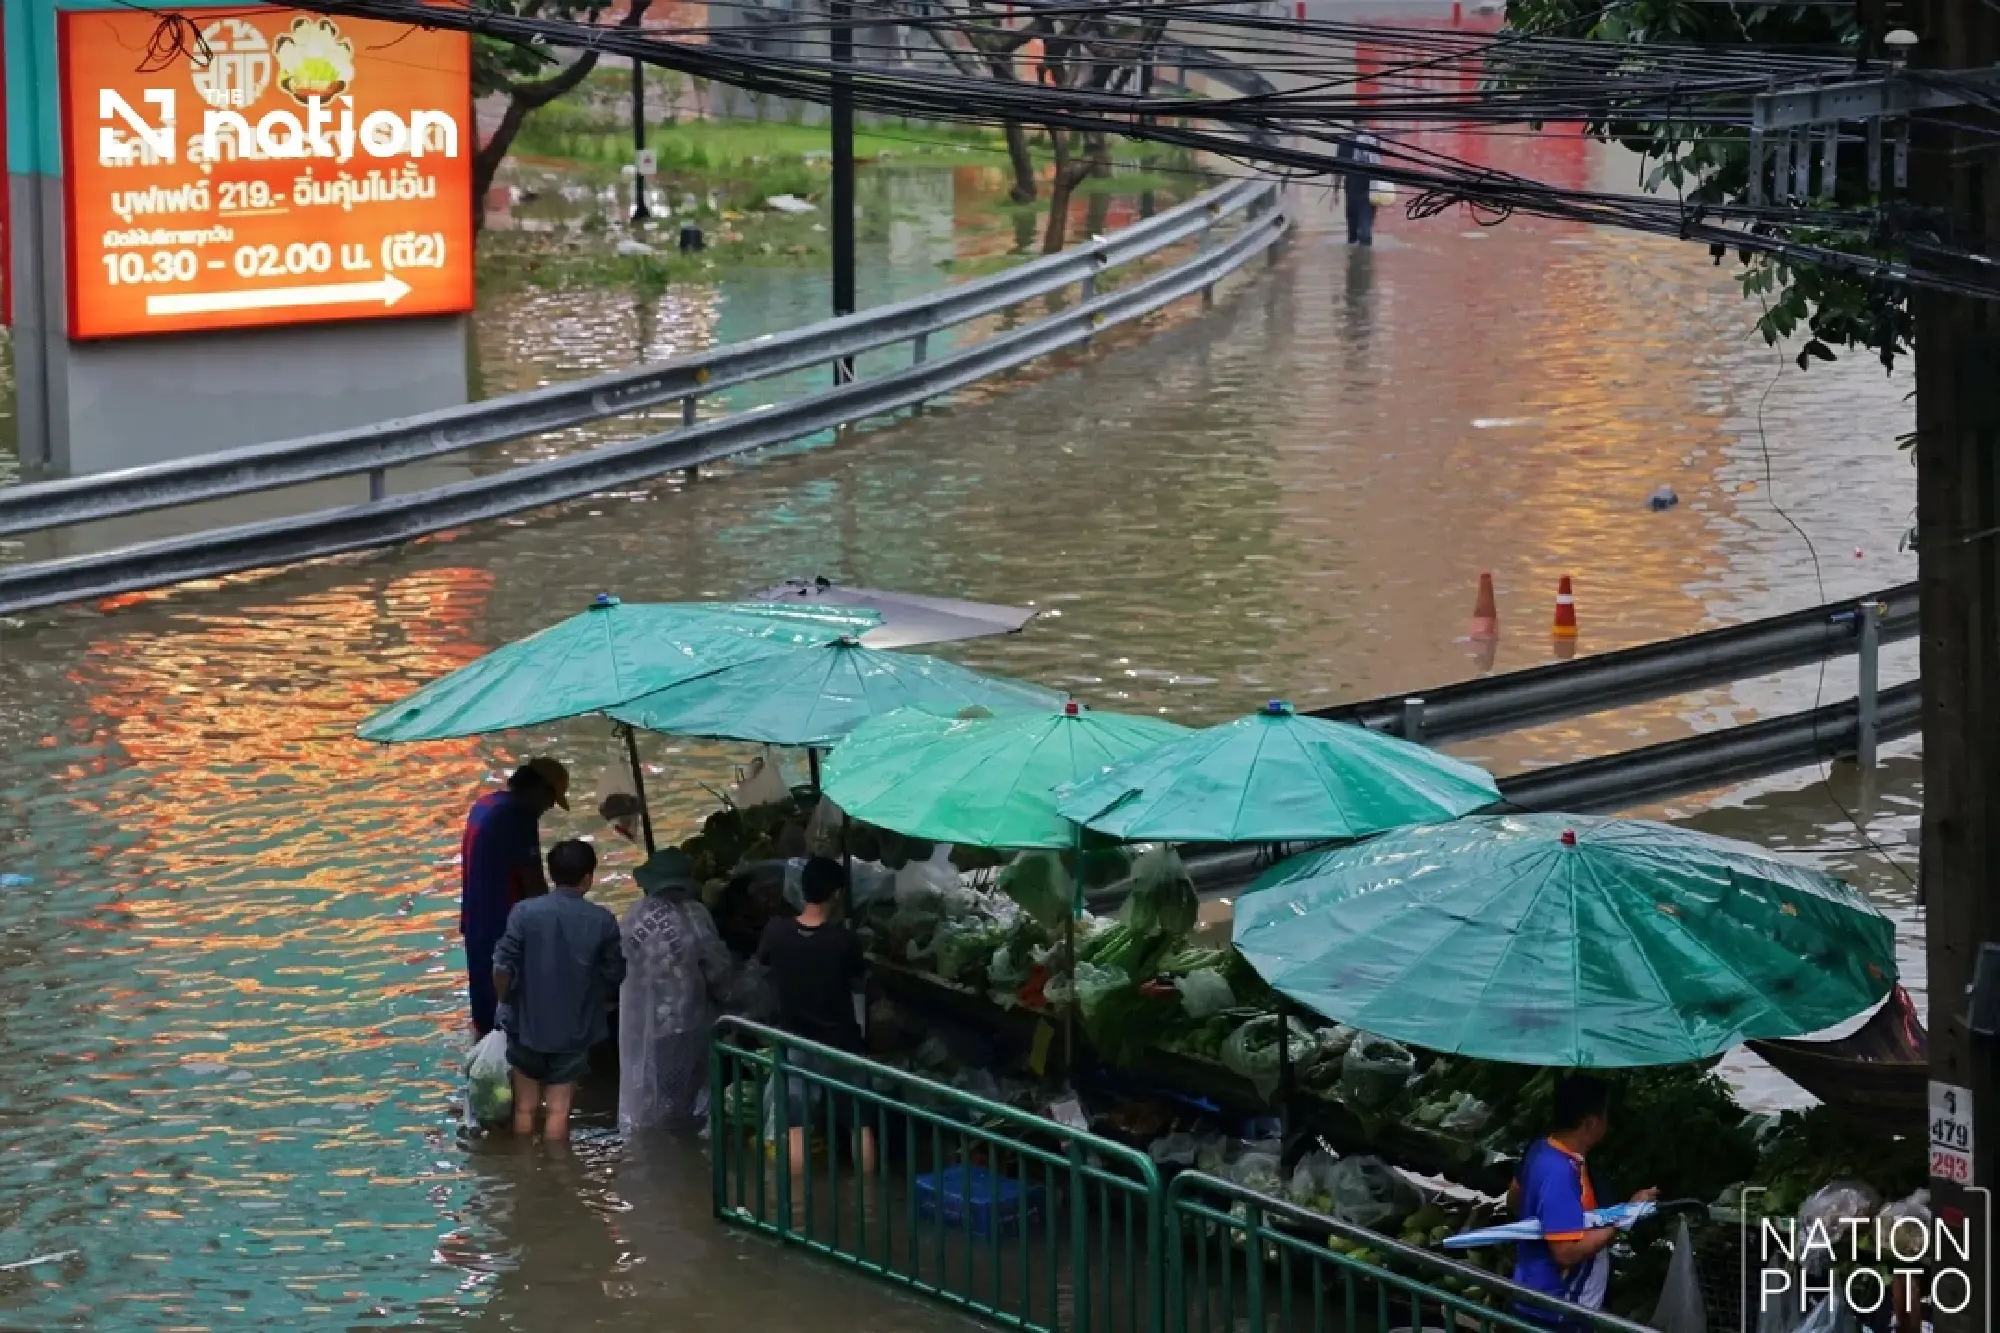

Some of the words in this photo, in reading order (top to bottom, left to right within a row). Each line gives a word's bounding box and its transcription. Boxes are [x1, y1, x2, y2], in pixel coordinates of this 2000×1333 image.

[103, 250, 198, 285] 10.30
[234, 243, 332, 278] 02.00
[341, 244, 372, 270] น.
[381, 231, 445, 271] (ตี2)
[1932, 1117, 1968, 1147] 479
[1932, 1151, 1968, 1180] 293
